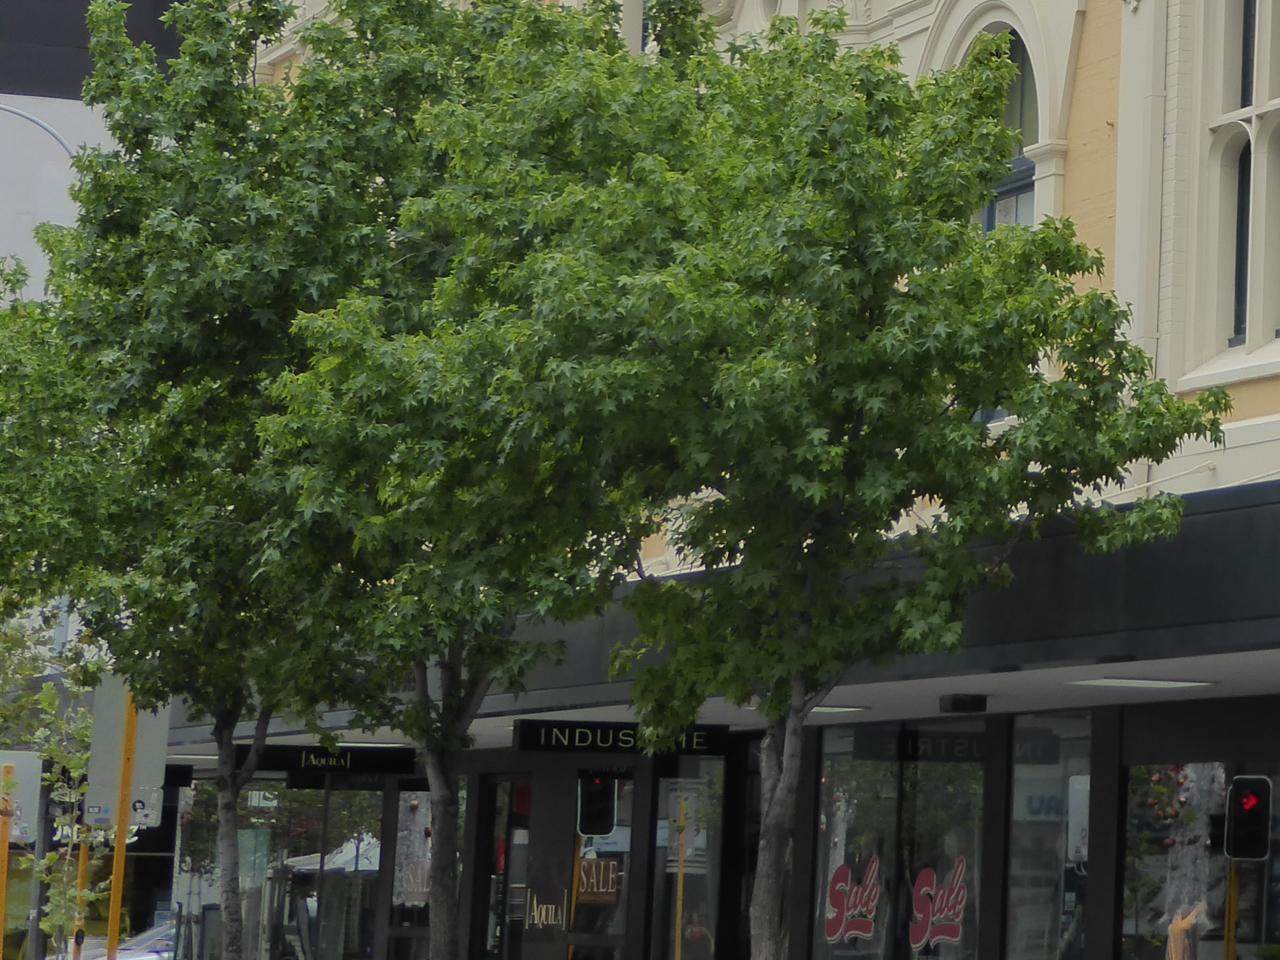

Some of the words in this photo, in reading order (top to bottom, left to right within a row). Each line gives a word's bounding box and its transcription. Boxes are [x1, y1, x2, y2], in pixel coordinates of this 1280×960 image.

[540, 728, 708, 750] INDUSIE
[406, 863, 430, 892] SAL
[579, 860, 619, 894] SALE
[825, 855, 880, 944] Sale
[910, 855, 967, 951] Sale
